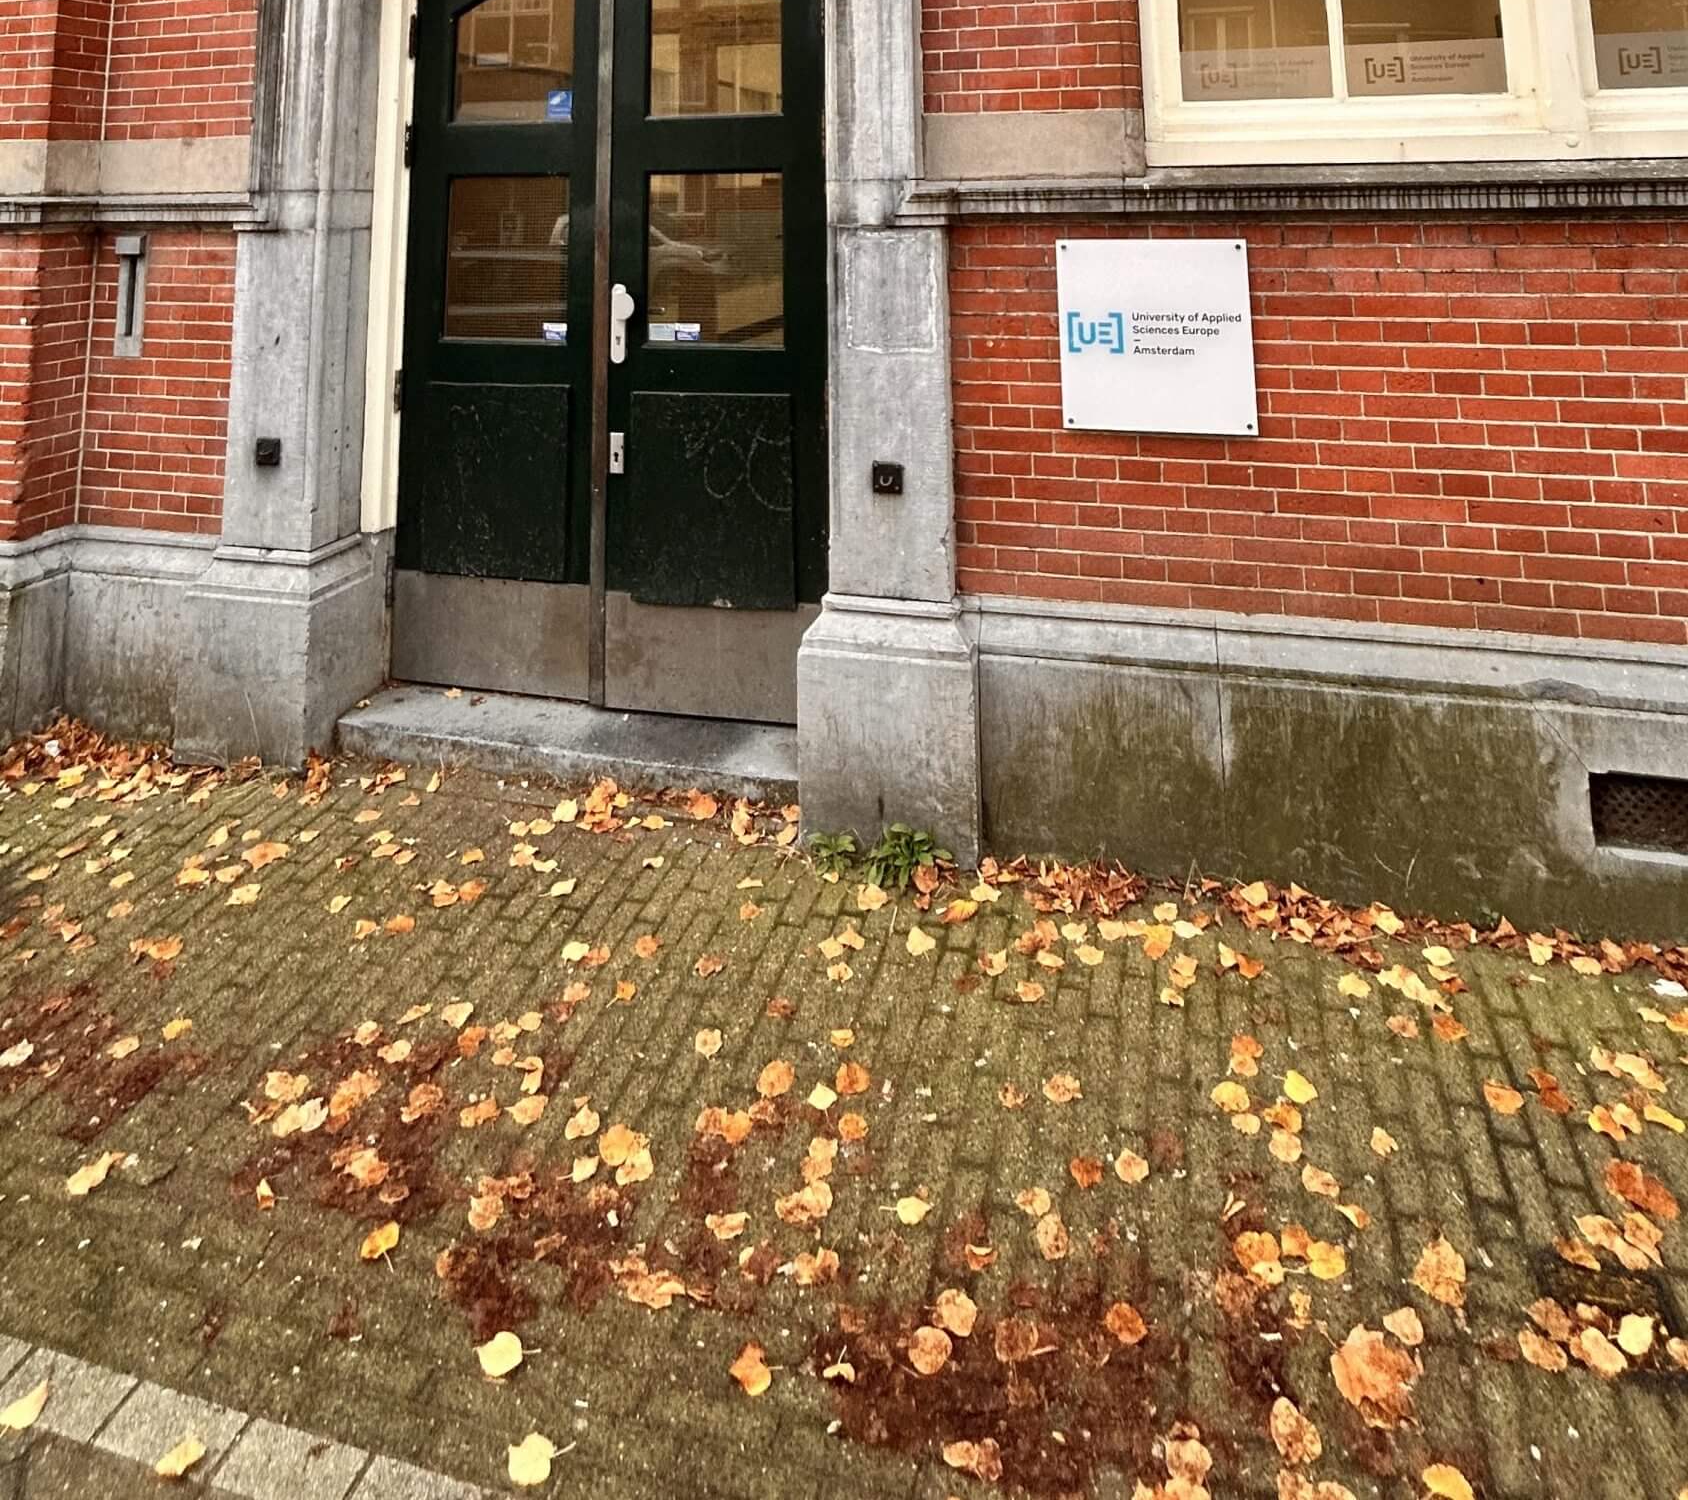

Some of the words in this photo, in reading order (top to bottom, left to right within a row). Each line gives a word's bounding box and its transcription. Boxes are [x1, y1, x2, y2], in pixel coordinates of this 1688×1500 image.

[1131, 311, 1185, 324] University
[1187, 312, 1199, 322] of
[1201, 312, 1242, 325] Applied
[1132, 325, 1180, 335] Sciences
[1182, 325, 1220, 338] Europe
[1133, 345, 1196, 356] Amsterdam
